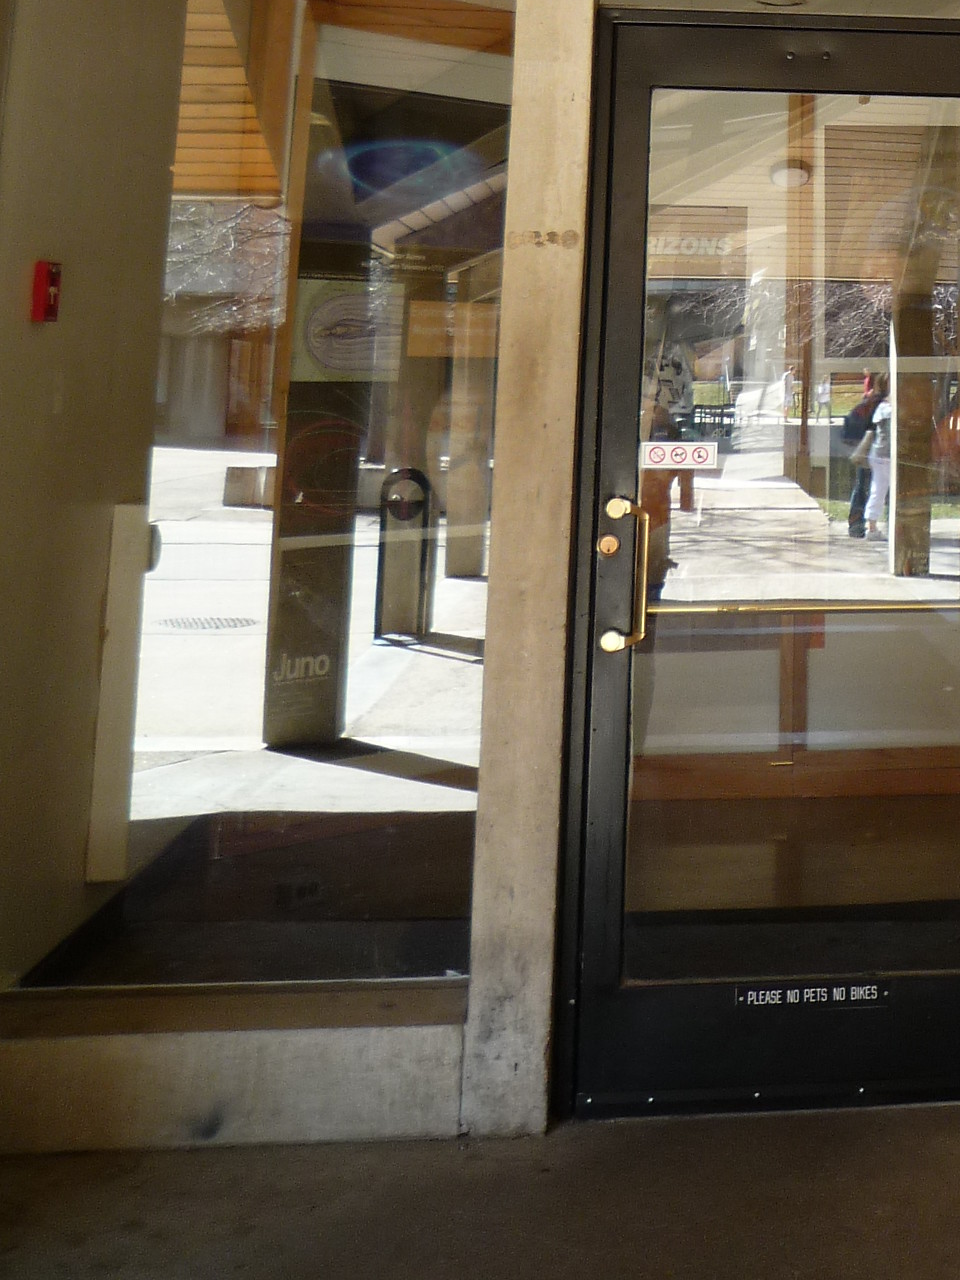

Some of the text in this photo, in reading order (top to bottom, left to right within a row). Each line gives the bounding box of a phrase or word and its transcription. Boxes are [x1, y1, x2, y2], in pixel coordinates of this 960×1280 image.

[273, 653, 331, 681] Juno
[747, 985, 878, 1005] PLEASE NO PETS NO BIKES
